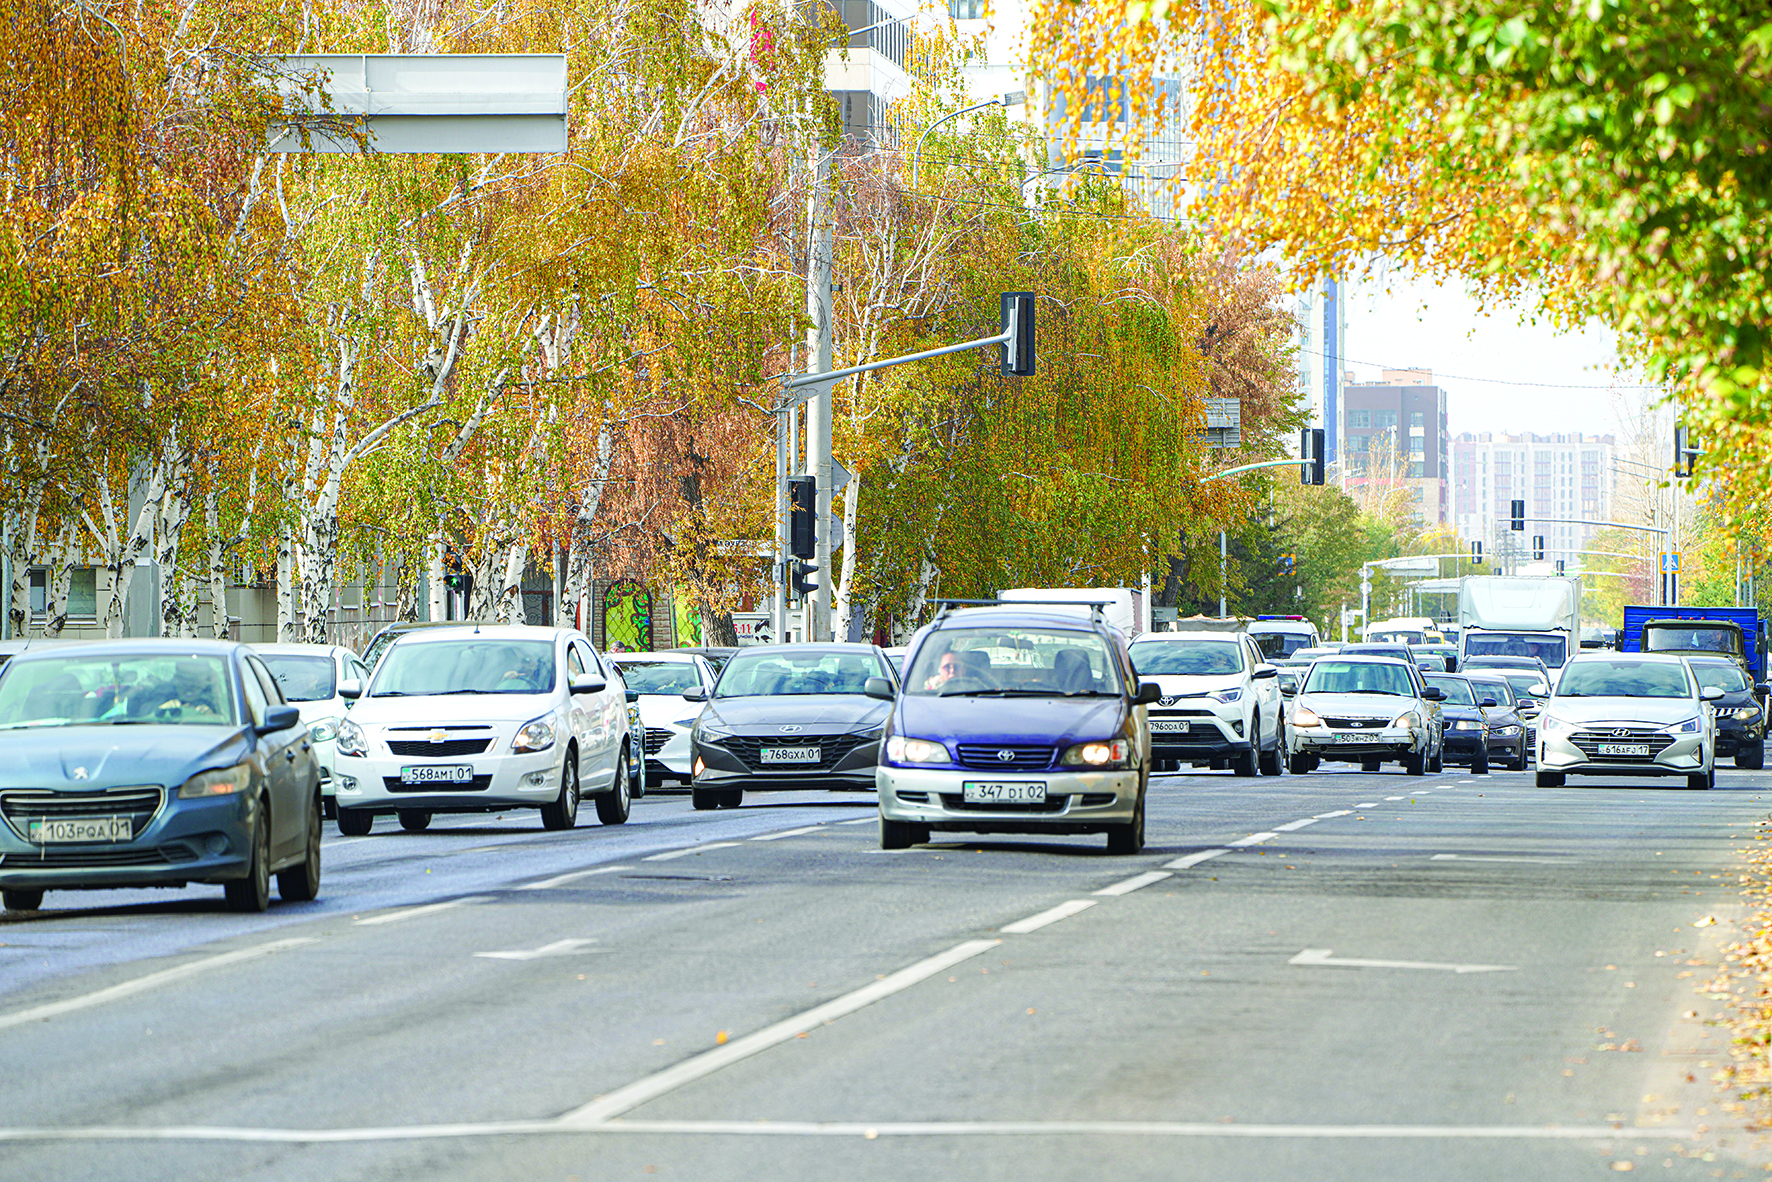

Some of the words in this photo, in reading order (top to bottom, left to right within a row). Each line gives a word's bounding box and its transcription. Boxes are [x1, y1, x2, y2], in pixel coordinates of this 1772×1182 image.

[769, 749, 806, 760] 768GXA
[808, 748, 820, 759] 01
[412, 768, 453, 781] 568AMI
[457, 767, 472, 780] 01
[979, 784, 1003, 799] 347
[1027, 785, 1044, 799] 02
[46, 822, 106, 840] 103PQA
